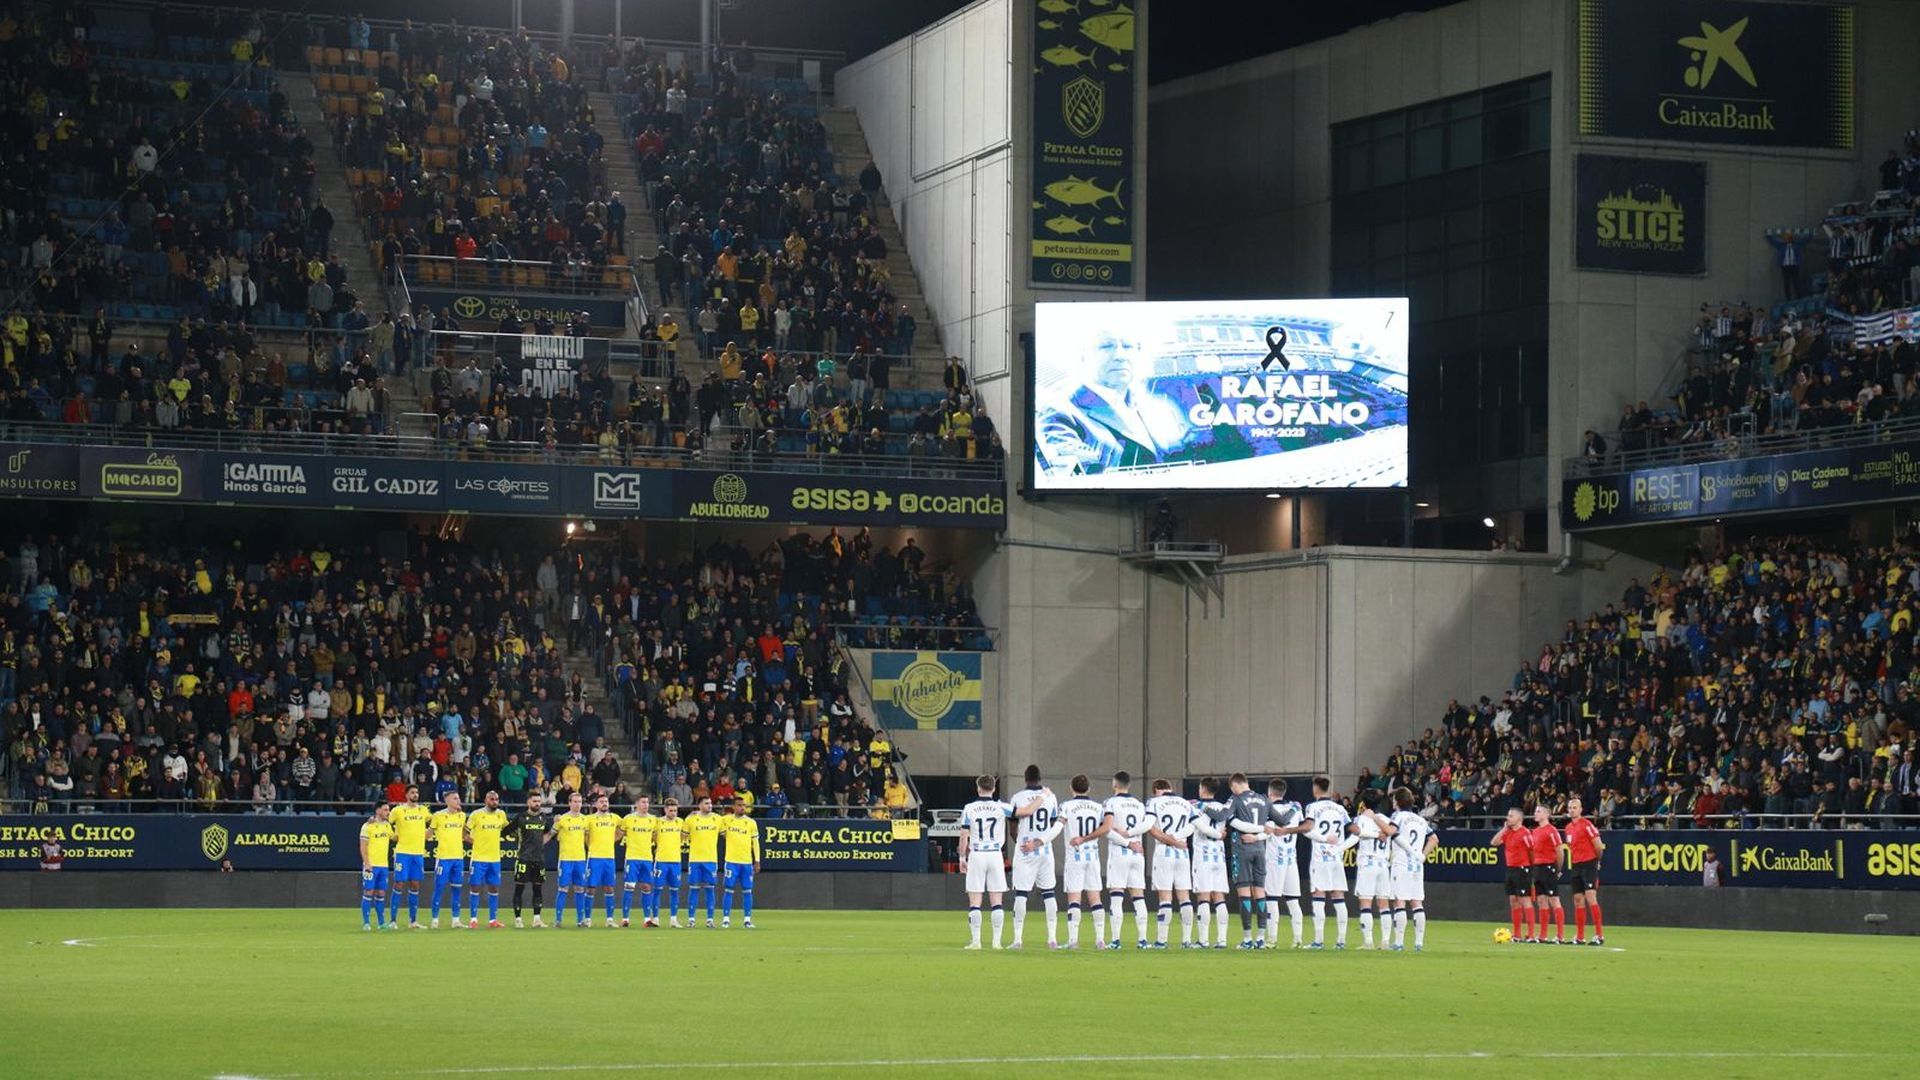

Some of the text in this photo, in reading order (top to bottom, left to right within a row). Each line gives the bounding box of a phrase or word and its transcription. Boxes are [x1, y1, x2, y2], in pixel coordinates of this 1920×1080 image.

[1658, 99, 1775, 130] CaixaBank
[1597, 209, 1684, 243] SLICE
[1044, 244, 1120, 257] petacachico.com
[536, 359, 572, 369] EN EL
[1222, 375, 1337, 398] RAFAEL
[1189, 397, 1369, 426] GARÓFANO
[1895, 452, 1910, 463] NO
[334, 467, 367, 476] GRUAS
[224, 481, 307, 494] Hnos García
[332, 477, 439, 496] GIL CADIZ
[455, 479, 484, 490] LAS
[1635, 472, 1692, 502] RESET
[791, 487, 867, 512] asisa
[920, 493, 1004, 514] coanda
[1599, 485, 1619, 514] bp
[690, 503, 769, 518] ABUELOBREAD
[0, 823, 136, 841] ETACA CHICO
[975, 816, 998, 842] 17
[1076, 815, 1097, 837] 10
[234, 834, 330, 846] ALMADRABA
[765, 827, 893, 844] PETACA CHICO
[87, 846, 134, 858] EXPORT
[765, 850, 893, 860] FISH & SEAFOOD EXPORT
[1761, 848, 1834, 872] CaixaBank
